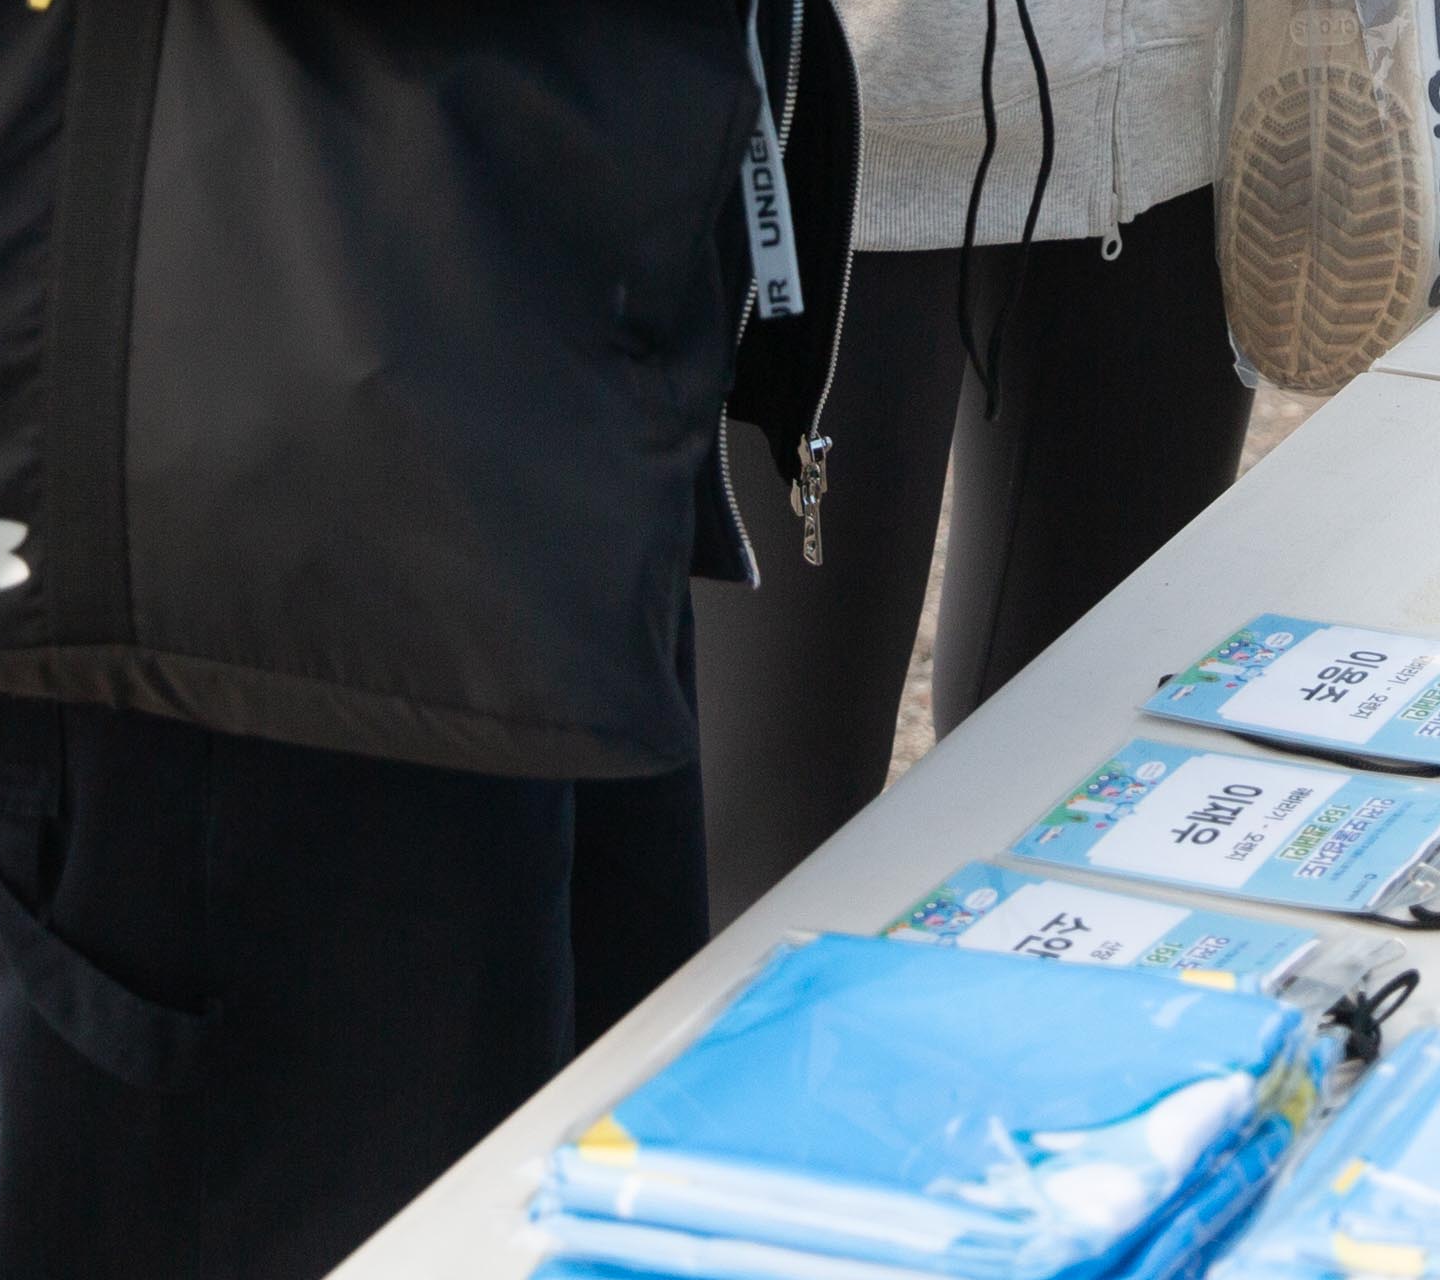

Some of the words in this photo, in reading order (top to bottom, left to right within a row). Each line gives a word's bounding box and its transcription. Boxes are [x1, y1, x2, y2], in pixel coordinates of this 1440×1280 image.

[750, 127, 782, 249] UNDE
[1289, 648, 1393, 705] 이용주
[1347, 693, 1392, 719] 오렌지
[1162, 781, 1268, 848] 이재우
[1263, 786, 1316, 821] 해바라기
[1314, 802, 1354, 824] 168
[1354, 796, 1398, 820] 인천
[1222, 831, 1269, 862] 오렌지
[1278, 823, 1334, 860] 캠페인
[1294, 818, 1374, 879] 보물섬지도
[1087, 939, 1125, 961] 산장
[1146, 940, 1185, 964] 168
[1184, 933, 1232, 962] 인천
